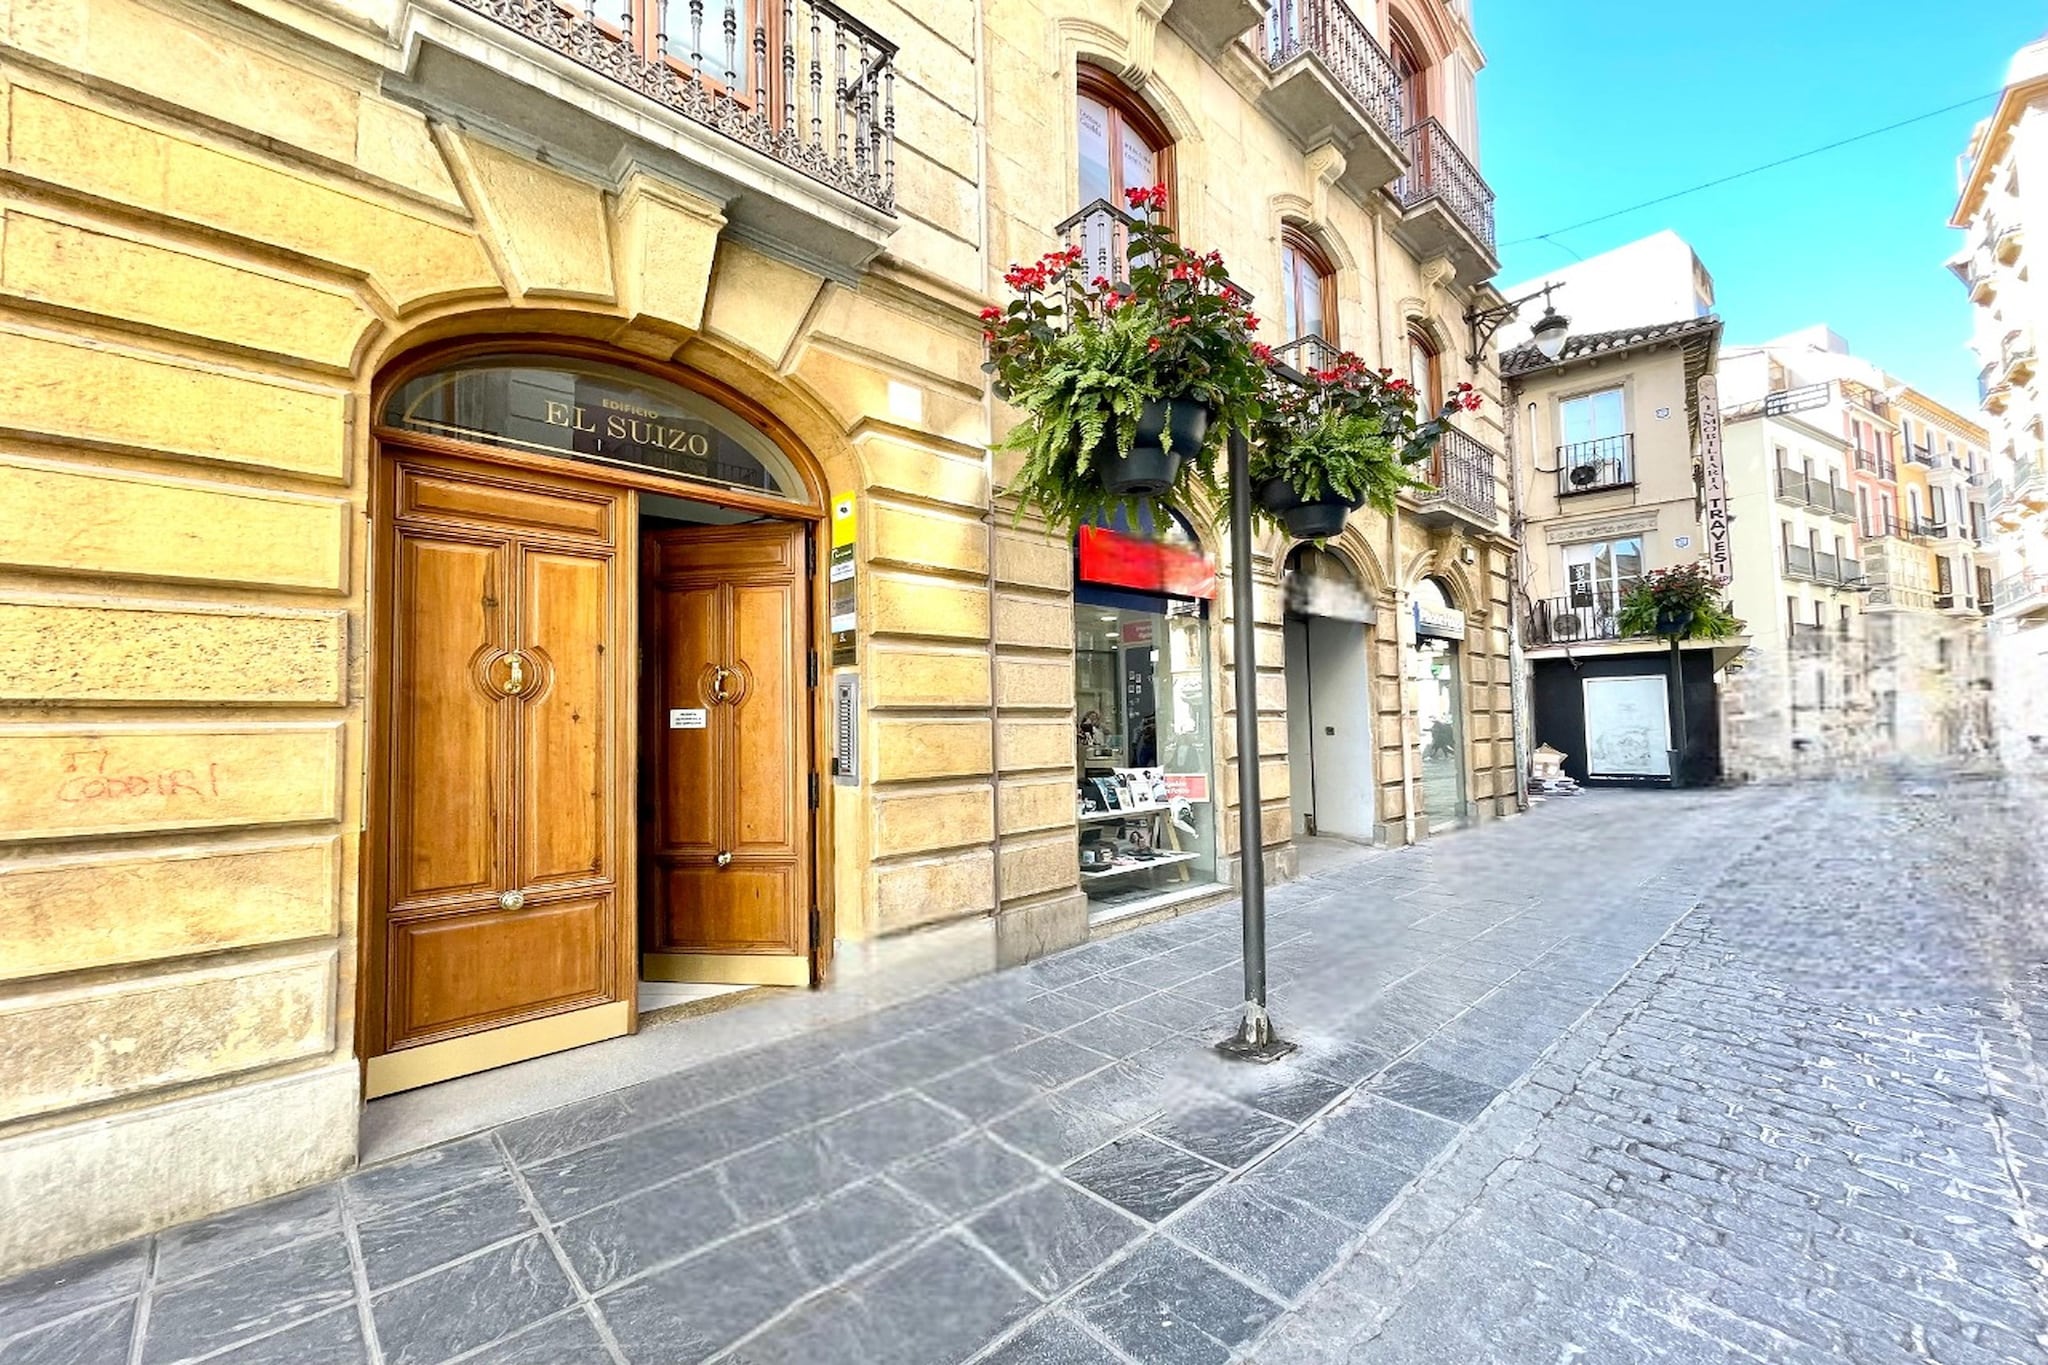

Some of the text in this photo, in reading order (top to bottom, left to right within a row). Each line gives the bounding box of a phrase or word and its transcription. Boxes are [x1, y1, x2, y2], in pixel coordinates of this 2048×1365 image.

[544, 400, 709, 456] EL SUIZO
[602, 398, 659, 419] EDIFICIO
[1709, 498, 1727, 574] TRAVESI
